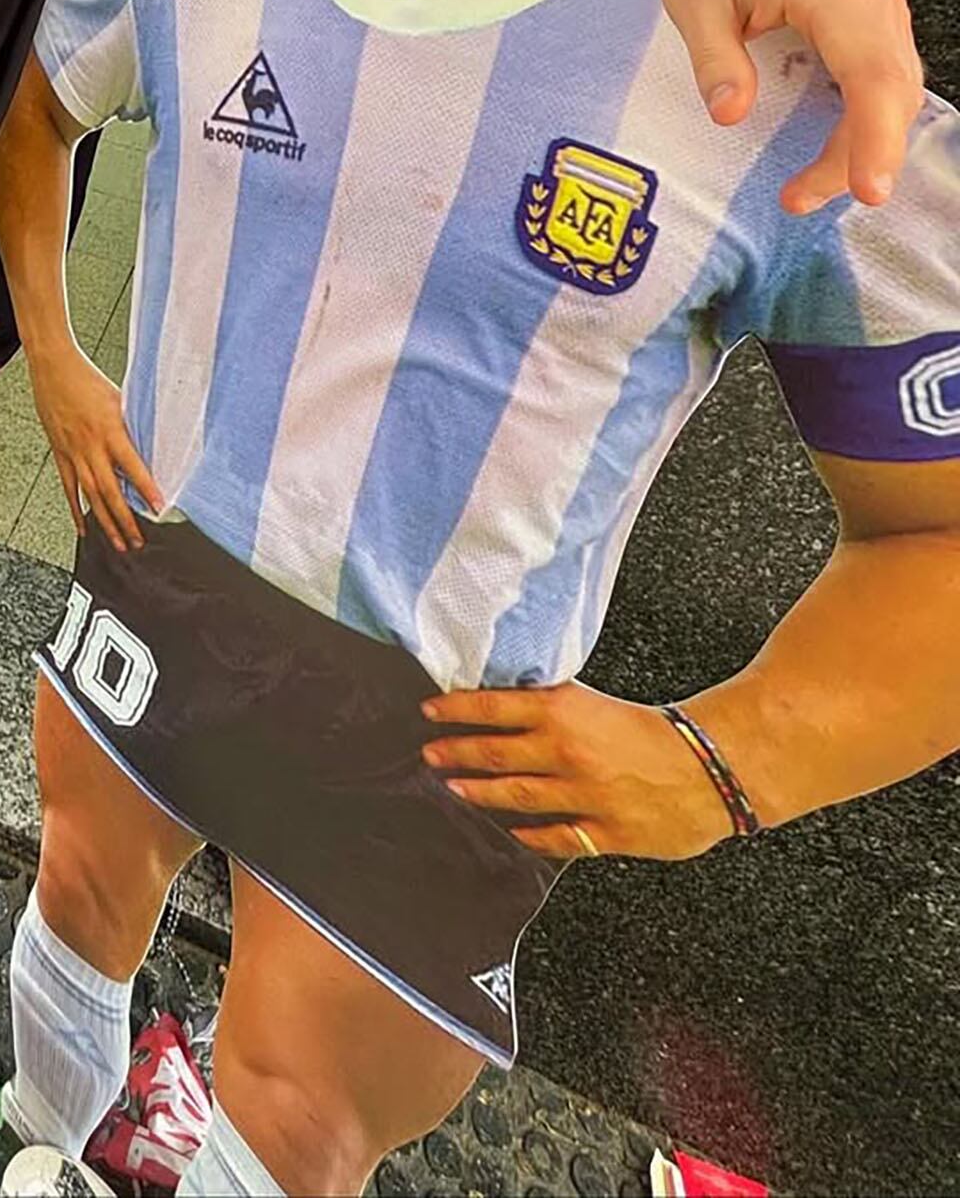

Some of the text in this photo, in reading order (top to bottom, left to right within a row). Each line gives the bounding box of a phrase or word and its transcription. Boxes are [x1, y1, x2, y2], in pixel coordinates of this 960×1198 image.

[203, 120, 307, 162] le coq sportif
[556, 188, 617, 247] AFA
[45, 580, 159, 727] 10
